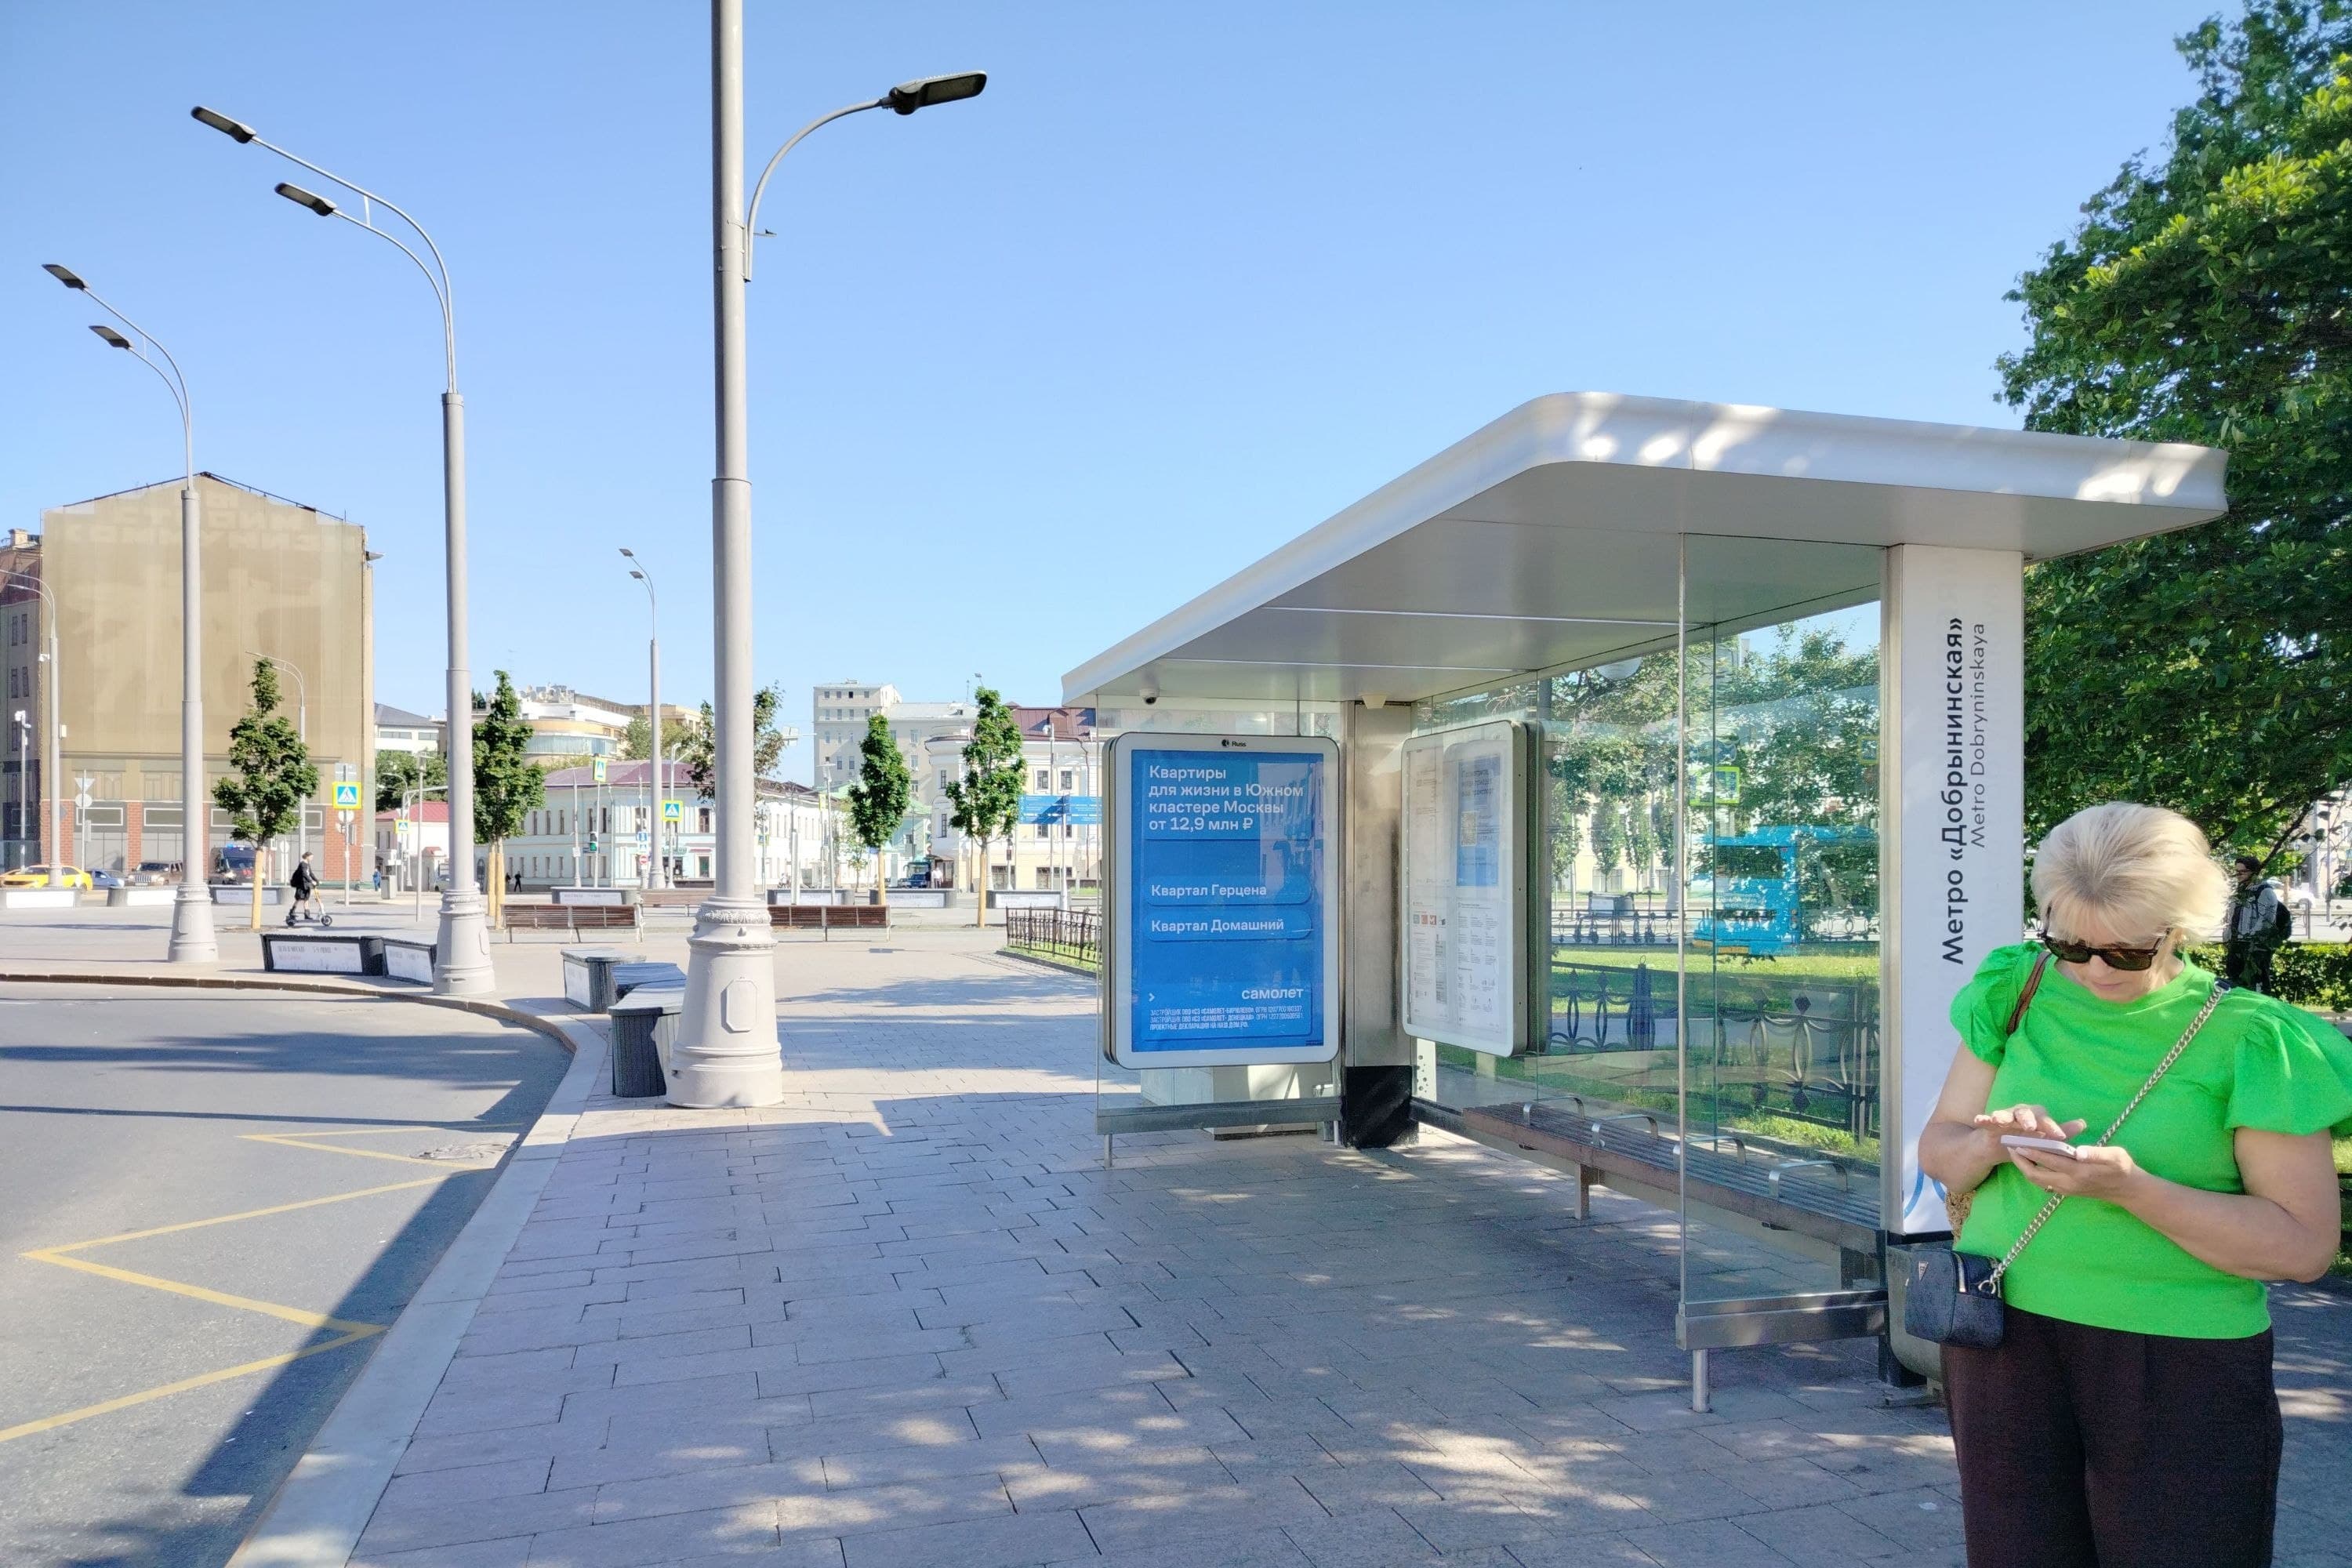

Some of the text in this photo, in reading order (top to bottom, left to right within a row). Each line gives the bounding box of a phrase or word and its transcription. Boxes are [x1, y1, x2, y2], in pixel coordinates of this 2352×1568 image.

[1969, 623, 1988, 848] Metro Dobryninskaya
[1149, 765, 1226, 782] Квартиры
[1149, 783, 1303, 797] для жизни в Южном
[1940, 617, 1969, 964] Метро «Добрынинская»
[1149, 800, 1283, 816] кластере Москвы
[1149, 819, 1166, 830] от
[1170, 818, 1204, 833] 12,9
[1208, 819, 1239, 830] млн
[1151, 884, 1267, 898] Квартал Герцена
[1151, 919, 1284, 934] Квартал Домашний
[1242, 989, 1304, 1000] самолет
